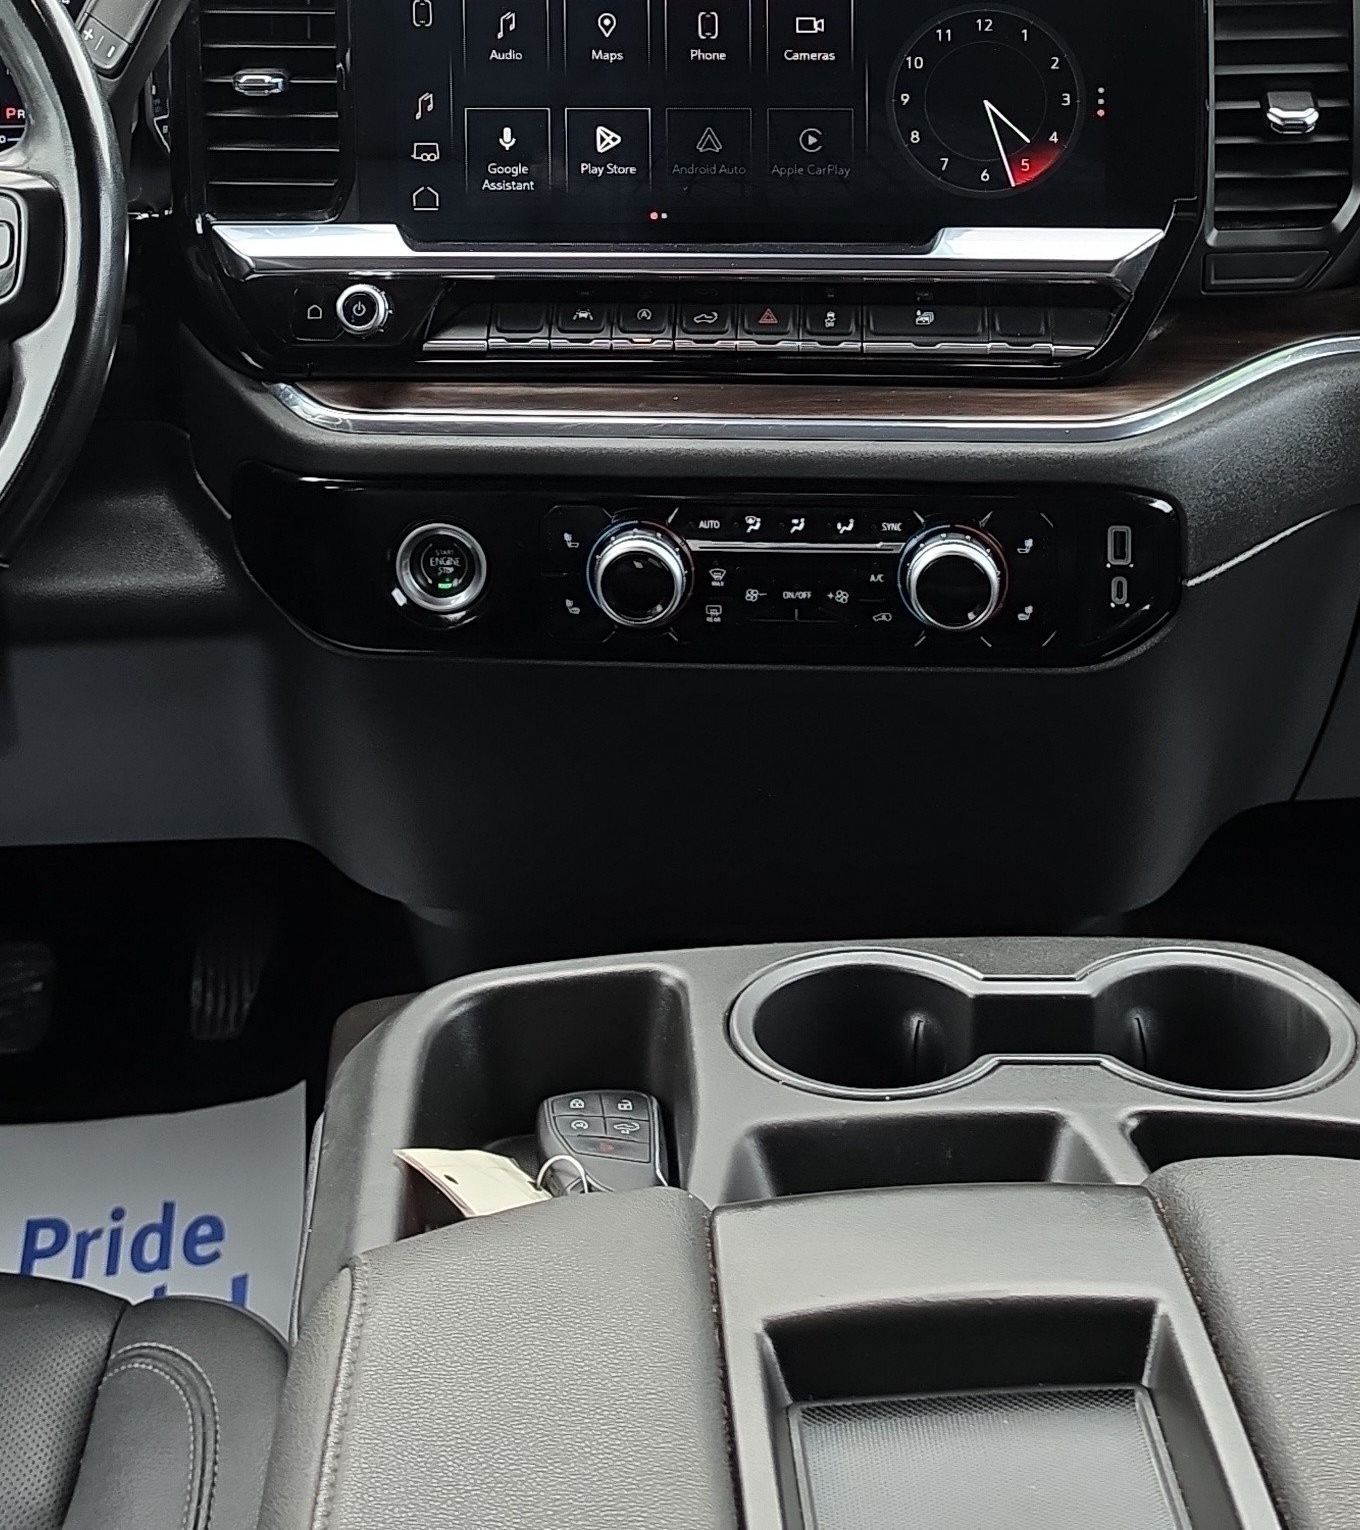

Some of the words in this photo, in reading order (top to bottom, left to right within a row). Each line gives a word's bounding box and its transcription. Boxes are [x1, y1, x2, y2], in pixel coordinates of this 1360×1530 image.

[976, 19, 994, 32] 12
[936, 29, 952, 42] 11
[1021, 29, 1029, 42] 1
[489, 49, 523, 61] Audio
[591, 49, 624, 63] Maps
[690, 49, 727, 61] Phone
[784, 49, 835, 62] Cameras
[906, 56, 923, 70] 10
[1050, 57, 1060, 70] 2
[900, 93, 910, 106] 9
[1061, 93, 1071, 106] 3
[5, 108, 17, 119] P
[910, 131, 920, 144] 8
[1048, 131, 1059, 144] 4
[487, 164, 529, 177] Google
[580, 164, 605, 177] Play
[606, 164, 637, 175] Store
[672, 164, 716, 176] Android
[717, 164, 747, 176] Auto
[772, 164, 804, 178] Apple
[806, 164, 851, 178] CarPlay
[941, 158, 949, 171] 7
[1021, 159, 1030, 172] 5
[980, 169, 990, 182] 6
[481, 179, 535, 192] Assistant
[699, 520, 721, 530] AUTO
[881, 521, 903, 532] SYNC
[429, 556, 461, 568] ENGINE
[869, 573, 884, 584] A/C
[783, 590, 813, 600] ON/OFF
[20, 1201, 228, 1279] Pride
